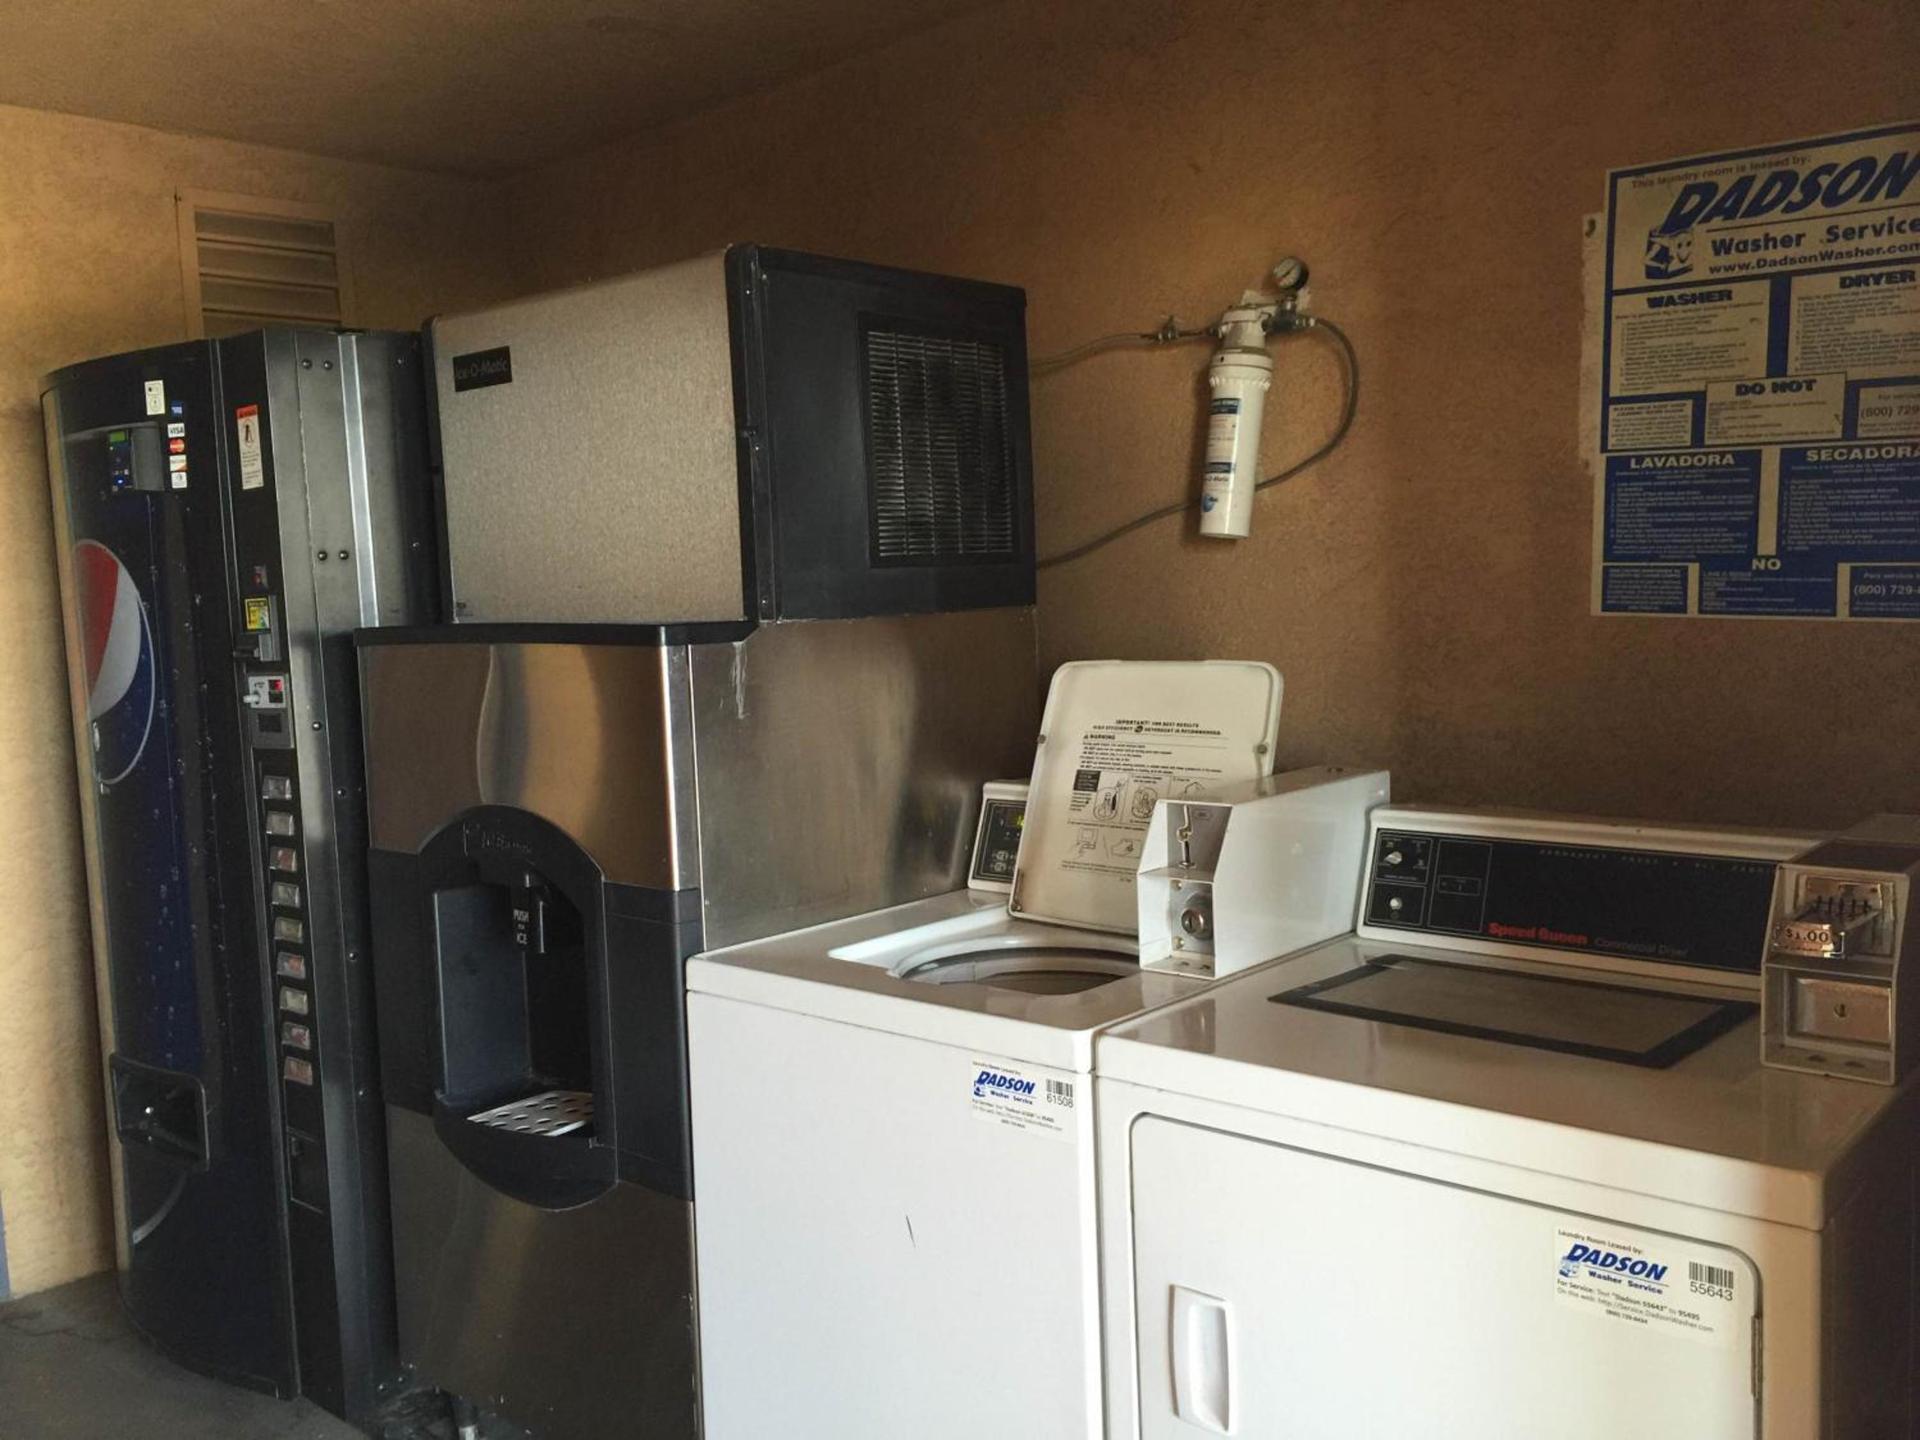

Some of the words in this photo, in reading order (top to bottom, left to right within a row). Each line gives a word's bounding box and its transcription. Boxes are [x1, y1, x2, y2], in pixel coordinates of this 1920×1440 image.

[1702, 167, 1733, 178] room
[1659, 152, 1920, 234] DADSON
[1711, 231, 1806, 256] Washer
[1826, 216, 1920, 244] Service
[1839, 269, 1916, 289] DRYER
[1646, 290, 1733, 309] WASHER
[1735, 382, 1766, 397] DO
[1771, 379, 1817, 394] NOT
[1630, 453, 1735, 469] LAVADORA
[1751, 558, 1781, 571] NO
[1853, 584, 1887, 597] (800)
[516, 933, 527, 944] ICE
[1488, 922, 1536, 939] Speed
[1538, 927, 1588, 945] Queen
[1786, 927, 1829, 942] $1.00
[976, 1070, 1036, 1095] DADSON
[1567, 1243, 1668, 1282] DADSON
[1588, 1270, 1622, 1285] Washer
[1627, 1279, 1664, 1295] Service
[1690, 1281, 1733, 1302] 55643
